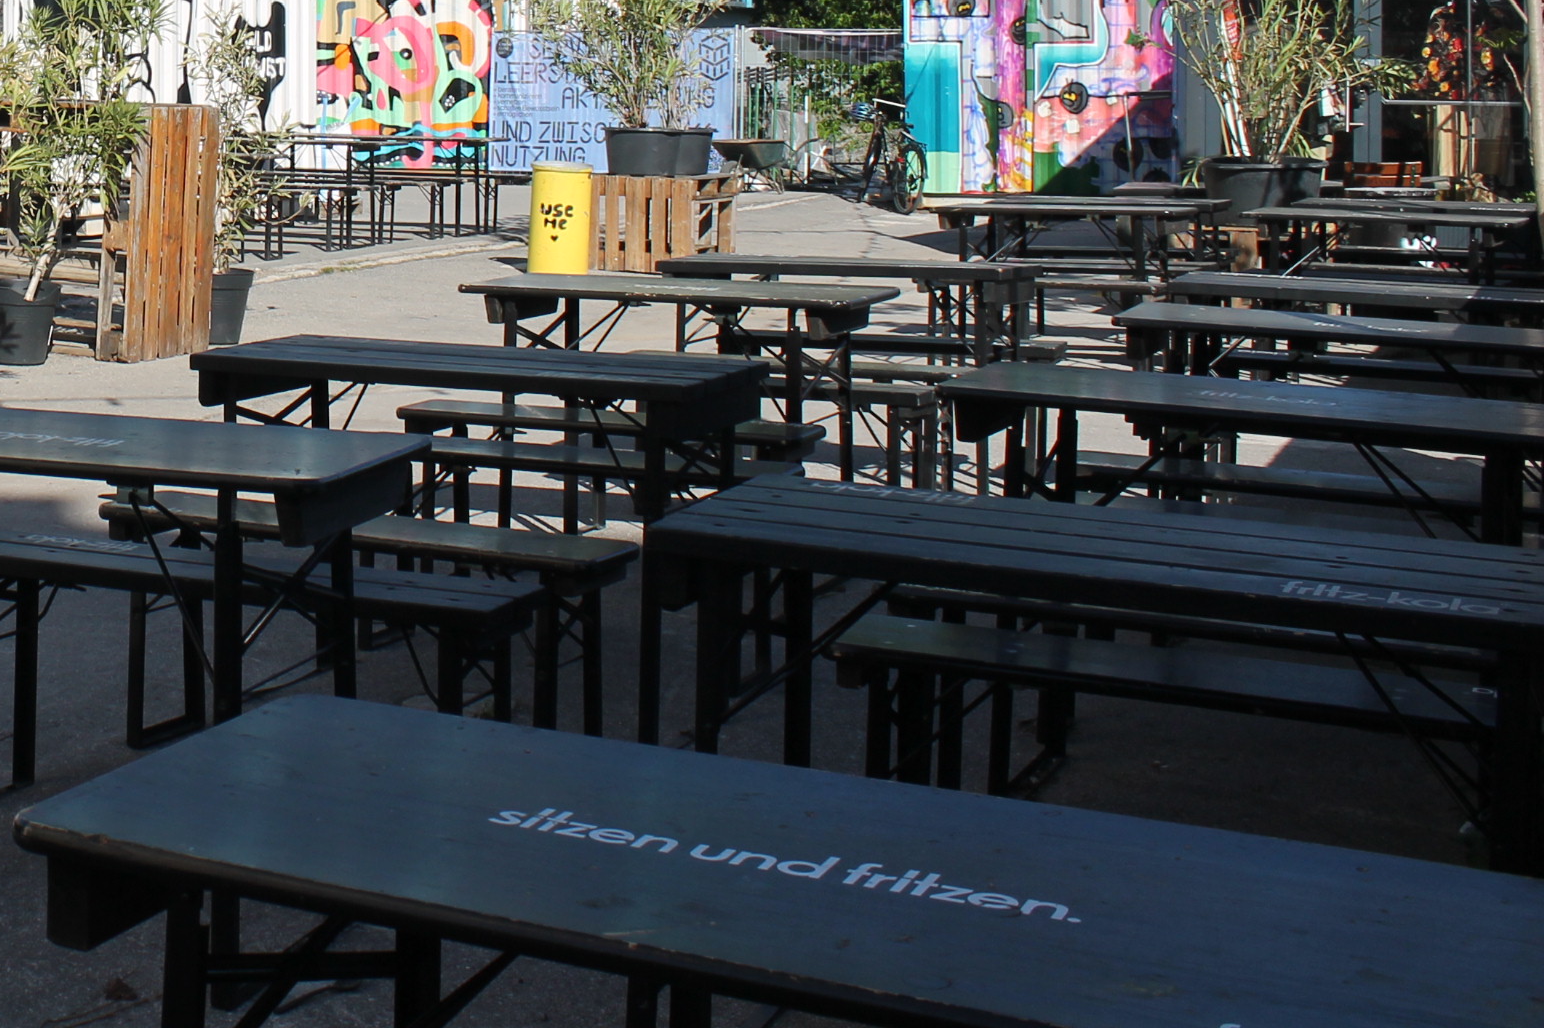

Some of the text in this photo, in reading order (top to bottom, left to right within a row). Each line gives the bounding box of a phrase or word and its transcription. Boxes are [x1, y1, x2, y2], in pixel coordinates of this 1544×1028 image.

[1281, 580, 1501, 615] fritz-kola
[489, 808, 1082, 924] sitzen und fritzen.
